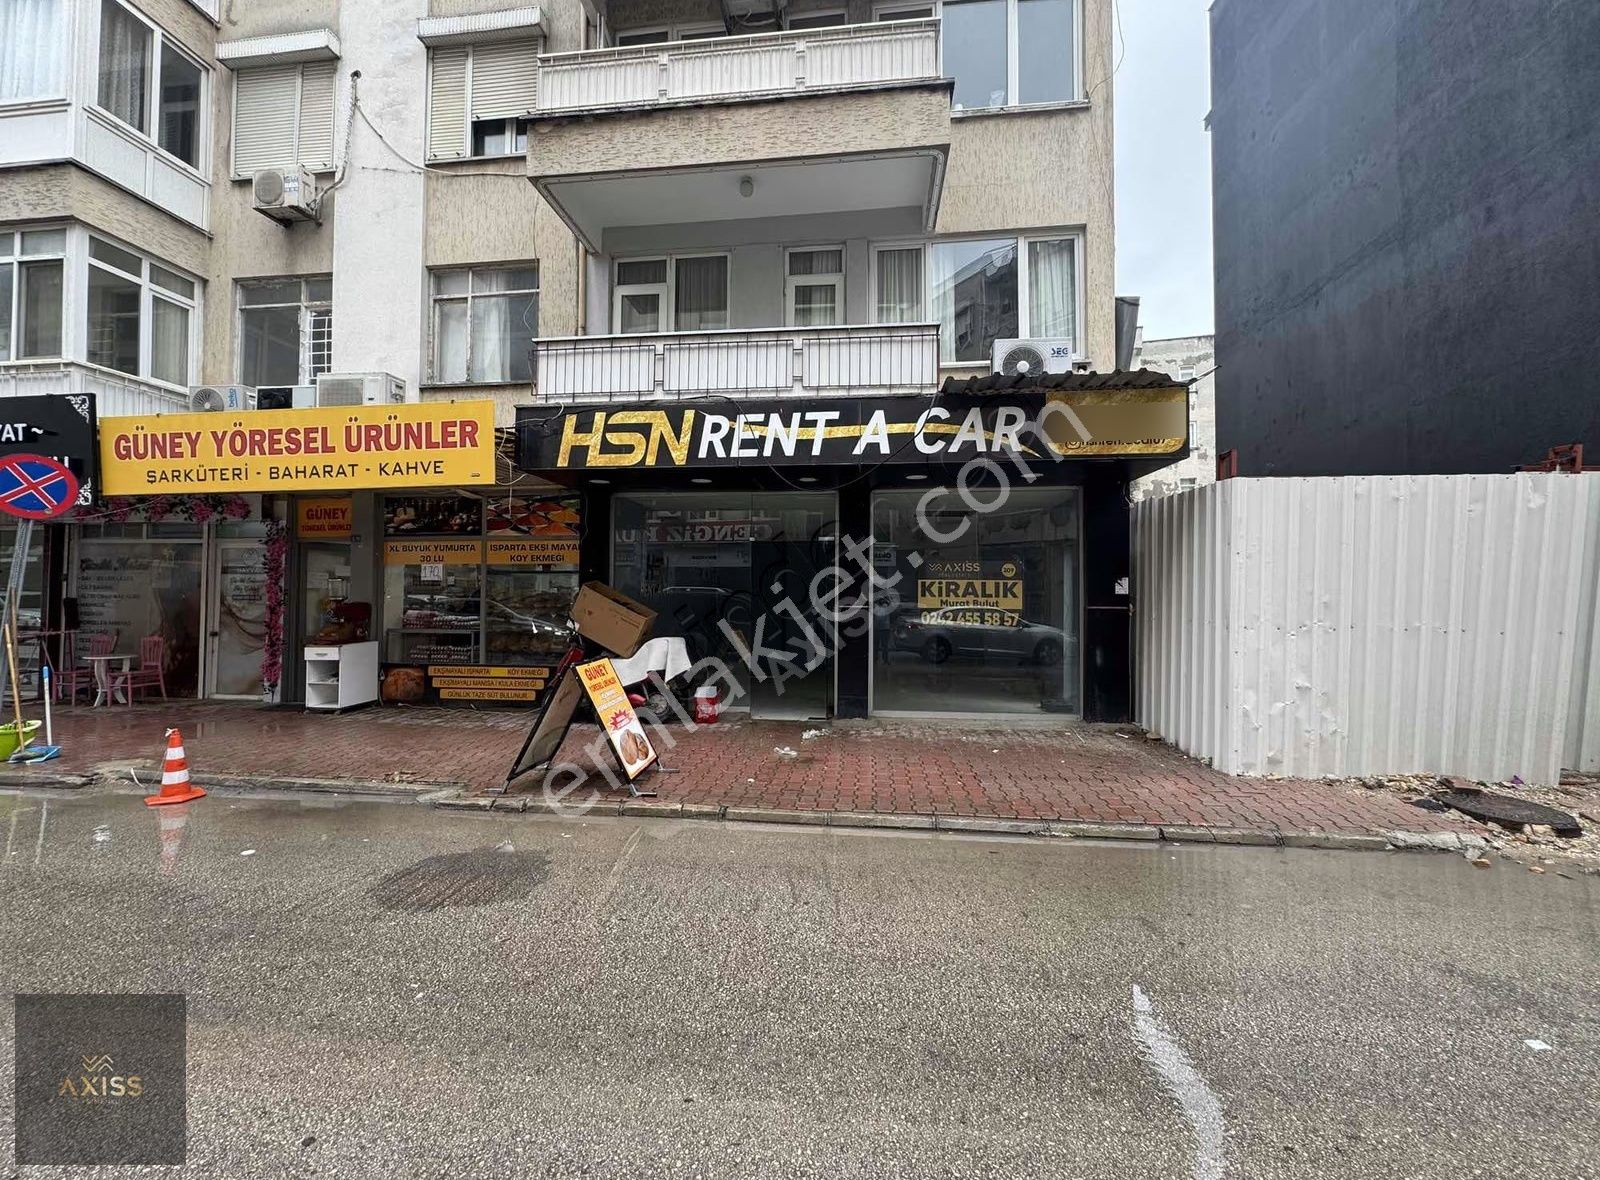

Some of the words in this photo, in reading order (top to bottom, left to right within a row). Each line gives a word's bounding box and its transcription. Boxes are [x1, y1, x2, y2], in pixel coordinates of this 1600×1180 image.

[1051, 347, 1068, 355] SEG
[229, 388, 238, 408] beko
[0, 423, 27, 442] AT
[114, 424, 202, 460] GÜNEY
[210, 421, 336, 458] YÖRESEL
[344, 414, 479, 452] ÜRÜNLER
[556, 409, 695, 467] HSN
[697, 411, 840, 459] RENT
[852, 409, 890, 455] A
[914, 406, 1026, 454] CAR
[146, 462, 249, 485] ŞARKÜTERİ
[269, 463, 358, 481] BAHARAT
[379, 460, 444, 477] KAHVE
[389, 544, 400, 552] XL
[433, 543, 476, 552] YUMURTA
[944, 562, 981, 573] AXISS
[940, 599, 970, 607] Murat
[973, 599, 999, 607] Bulut
[921, 611, 954, 625] 0242
[956, 611, 981, 625] 455
[984, 612, 1000, 625] 58
[1003, 612, 1019, 626] 57
